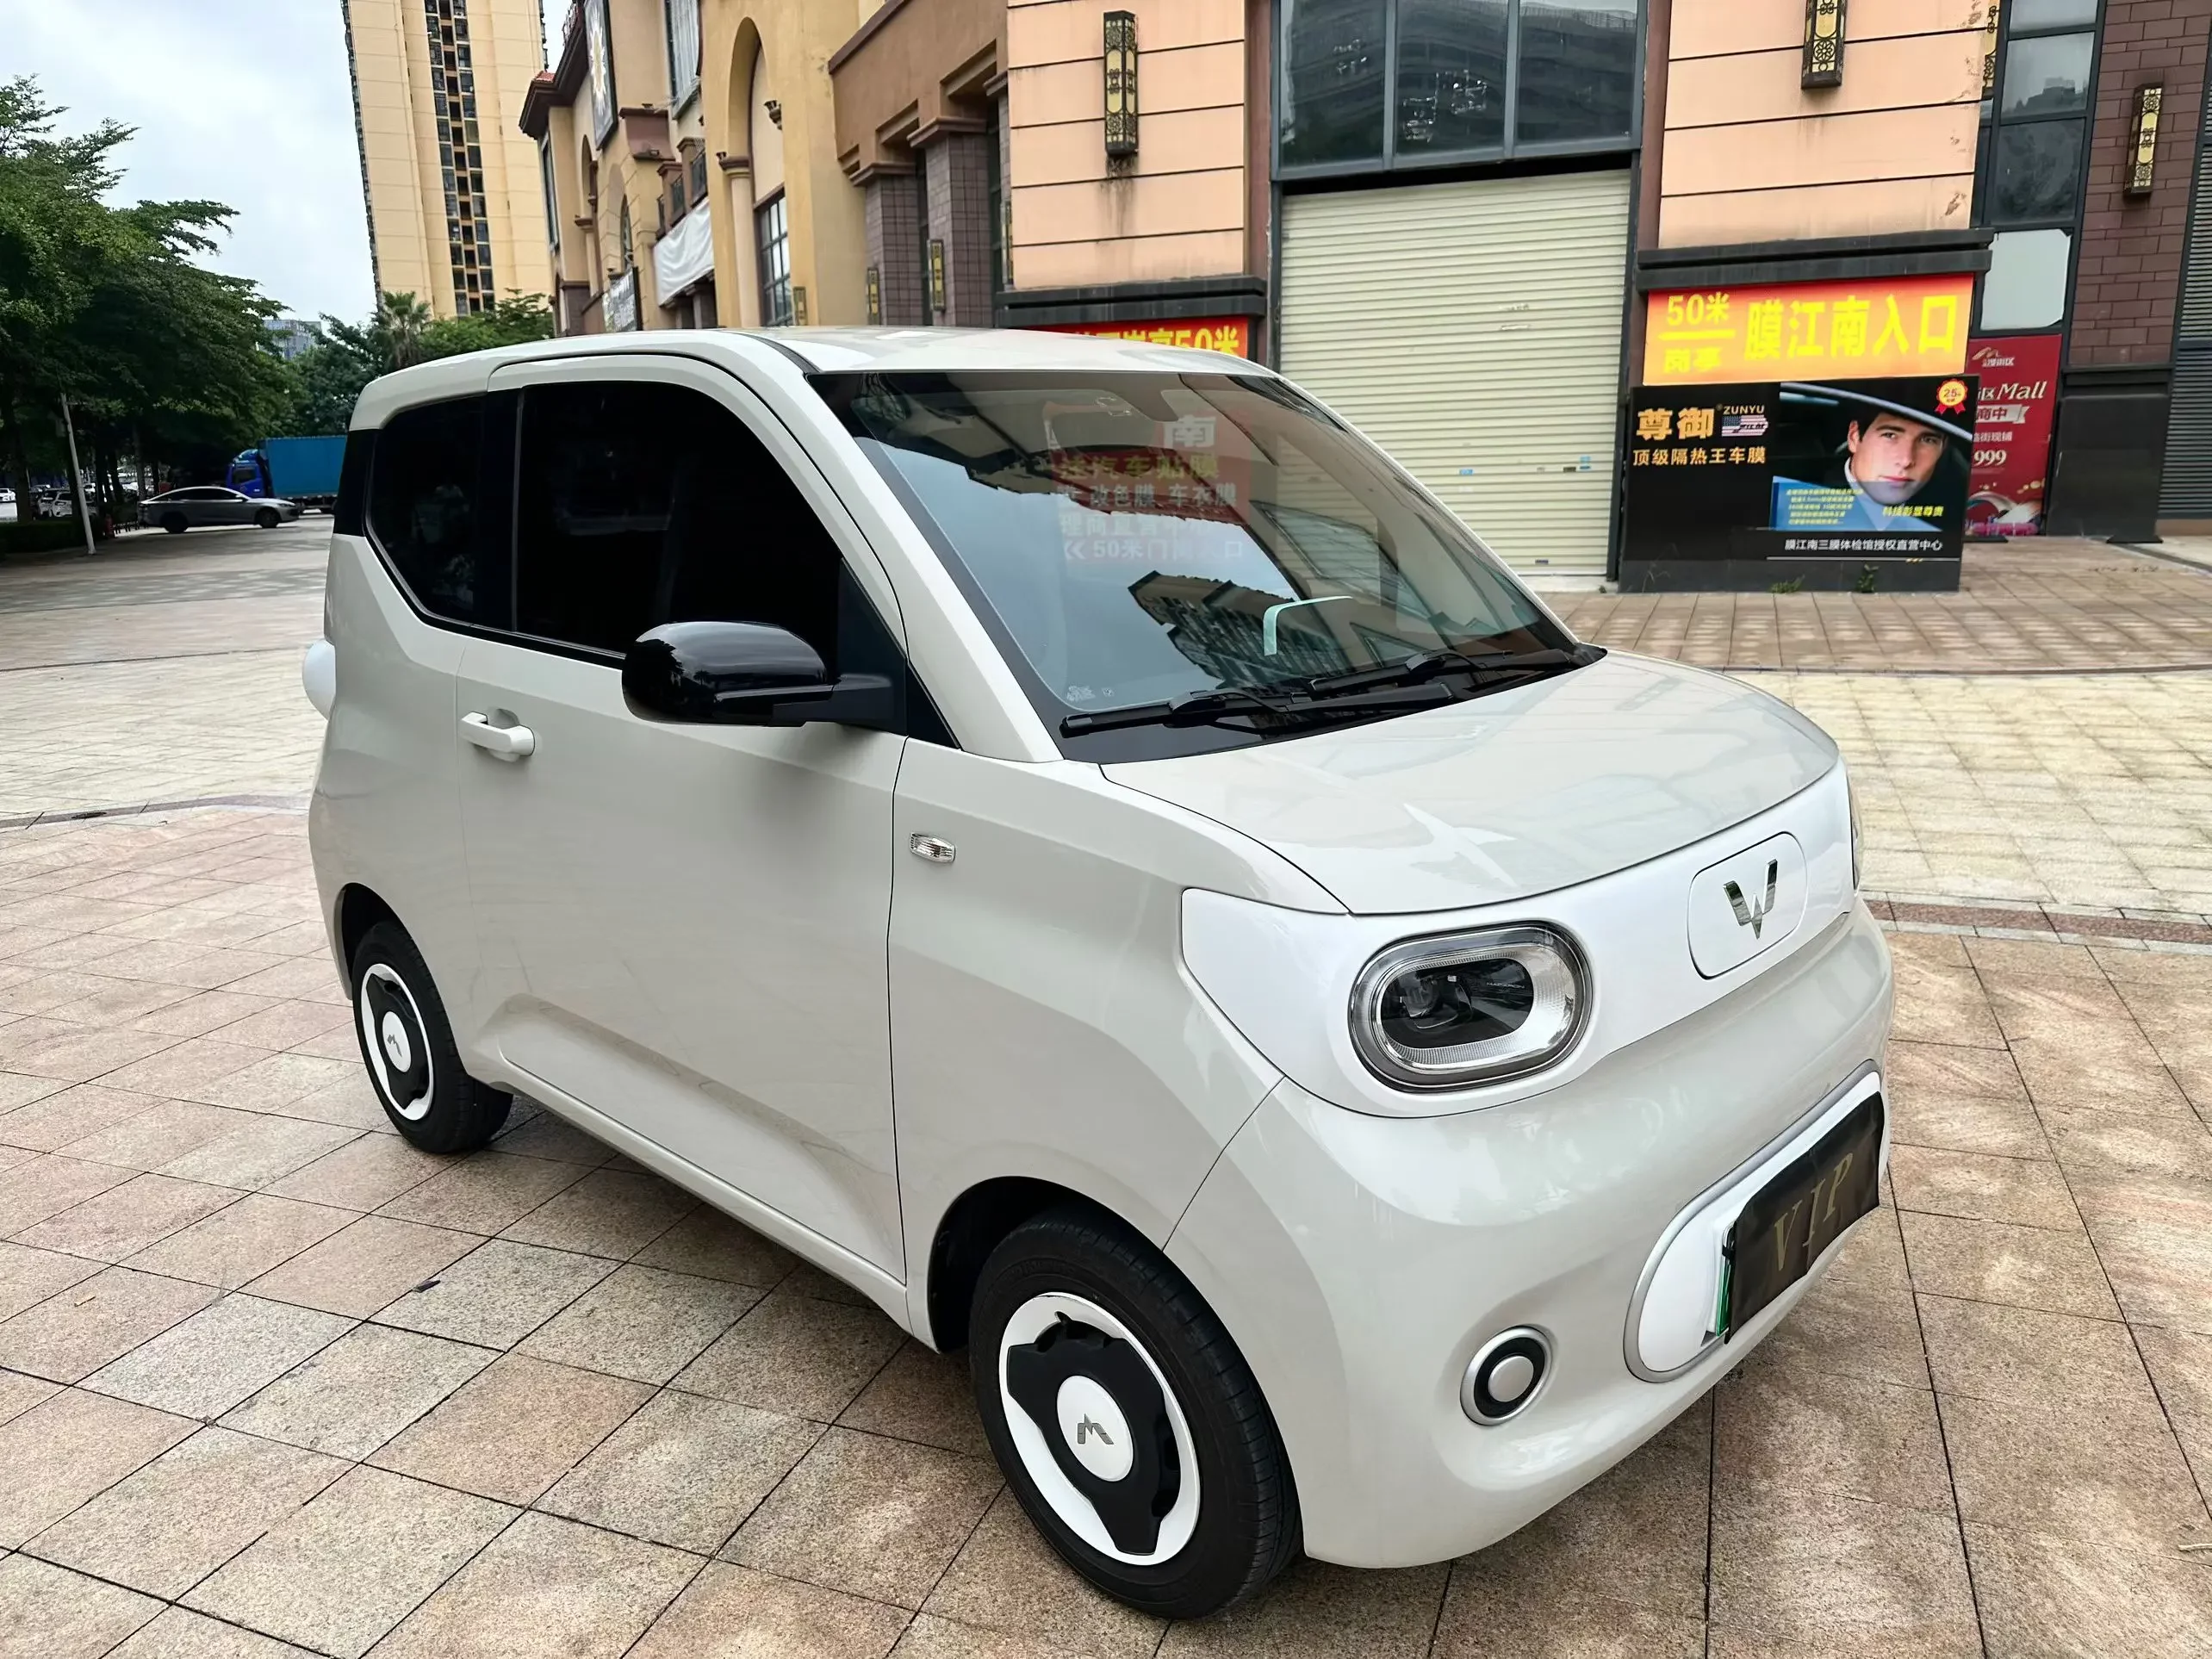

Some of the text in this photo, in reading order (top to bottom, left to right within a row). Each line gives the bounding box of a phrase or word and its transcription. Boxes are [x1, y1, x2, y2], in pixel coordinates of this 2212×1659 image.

[1667, 293, 1729, 326] 50米
[1745, 295, 1958, 360] 膜江南入口
[1637, 407, 1715, 440] 尊御
[1723, 406, 1765, 415] ZUNYU
[1632, 445, 1766, 466] 顶级隔热王车膜
[1774, 1153, 1854, 1271] VIP
